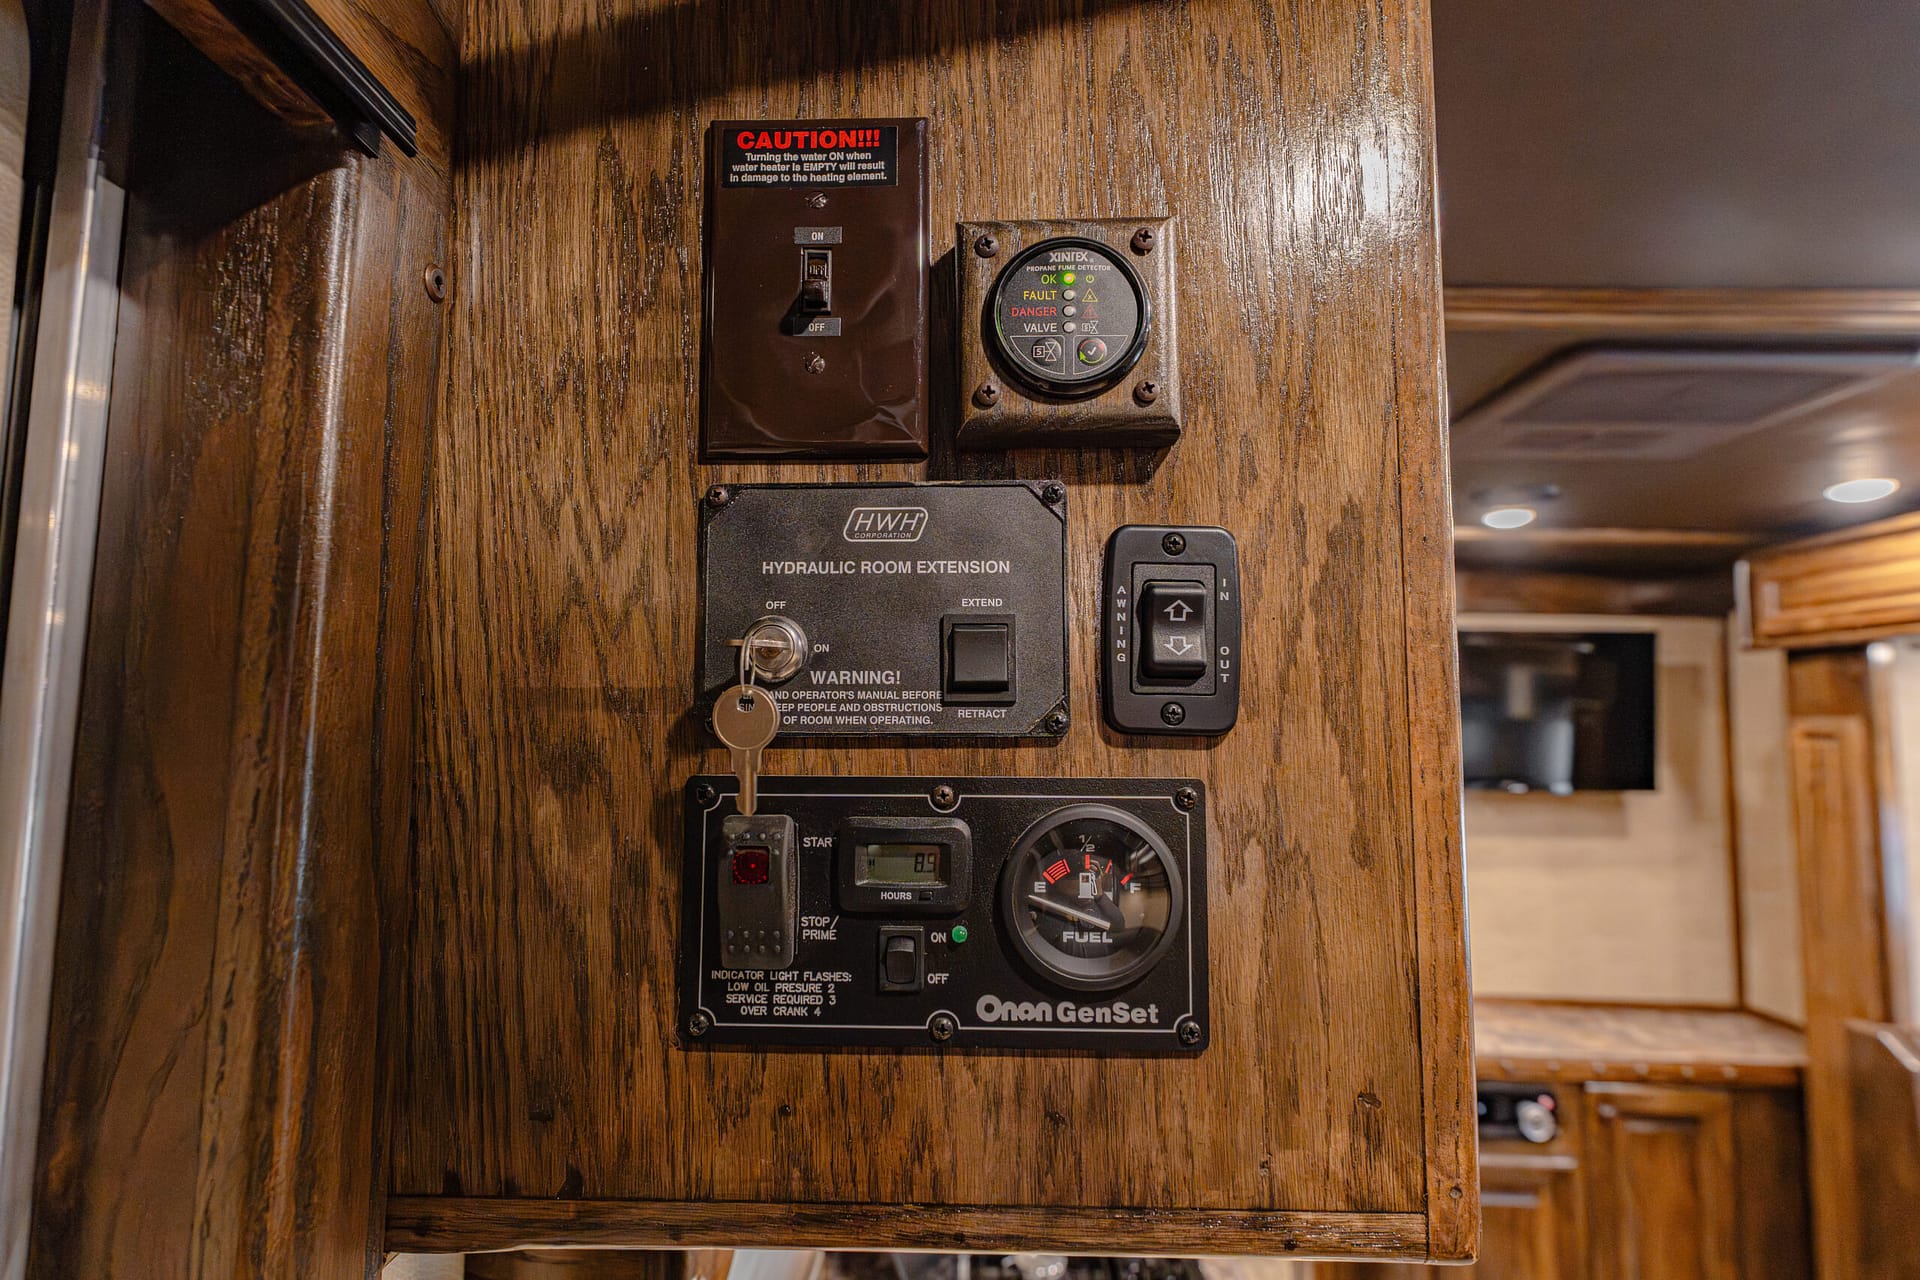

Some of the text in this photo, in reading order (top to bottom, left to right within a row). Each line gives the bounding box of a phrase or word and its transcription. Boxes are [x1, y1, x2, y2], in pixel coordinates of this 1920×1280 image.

[736, 130, 880, 150] CAUTION!!!
[745, 152, 872, 163] Turning the water ON when
[732, 161, 885, 172] water heater is EMPTY will result
[730, 172, 887, 183] in damage to the heating element.
[811, 232, 824, 240] ON
[1049, 252, 1088, 262] XINTEX
[1041, 274, 1057, 284] OK
[1023, 290, 1057, 300] FAULT
[1011, 307, 1057, 317] DANGER
[808, 323, 825, 332] OFF
[1024, 323, 1057, 332] VALVE
[854, 513, 920, 531] HWH
[762, 561, 1010, 575] HYDRAULIC ROOM EXTENSION
[1220, 578, 1229, 600] IN
[766, 601, 786, 610] OFF
[962, 598, 1003, 607] EXTEND
[1117, 585, 1126, 662] AWNING
[814, 644, 829, 653] ON
[1220, 646, 1230, 683] OUT
[810, 671, 900, 685] WARNING!
[792, 690, 854, 700] OPERATOR'S
[857, 691, 900, 700] MANUAL
[902, 691, 942, 700] BEFORE
[777, 703, 795, 712] EEP
[797, 703, 836, 712] PEOPLE
[840, 703, 861, 712] AND
[863, 703, 942, 712] OBSTRUCTIONS
[958, 709, 1007, 718] RETRACT
[783, 716, 933, 725] OF ROOM WHEN OPERATING.
[803, 836, 837, 848] STAR
[914, 853, 936, 872] 89
[1034, 882, 1047, 892] E
[1130, 883, 1141, 893] F
[881, 892, 912, 900] HOURS
[801, 915, 839, 929] STOP/
[802, 930, 837, 940] PRIME
[931, 932, 946, 943] ON
[1062, 931, 1112, 943] FUEL
[711, 970, 852, 982] INDICATOR LIGHT FLASHES:
[928, 974, 949, 984] OFF
[728, 983, 835, 993] LOW OIL PRESURE 2
[726, 994, 836, 1005] SERVICE REQUIRED 3
[740, 1006, 821, 1016] OVER CRANK 4
[976, 994, 1159, 1023] Onan GenSet
